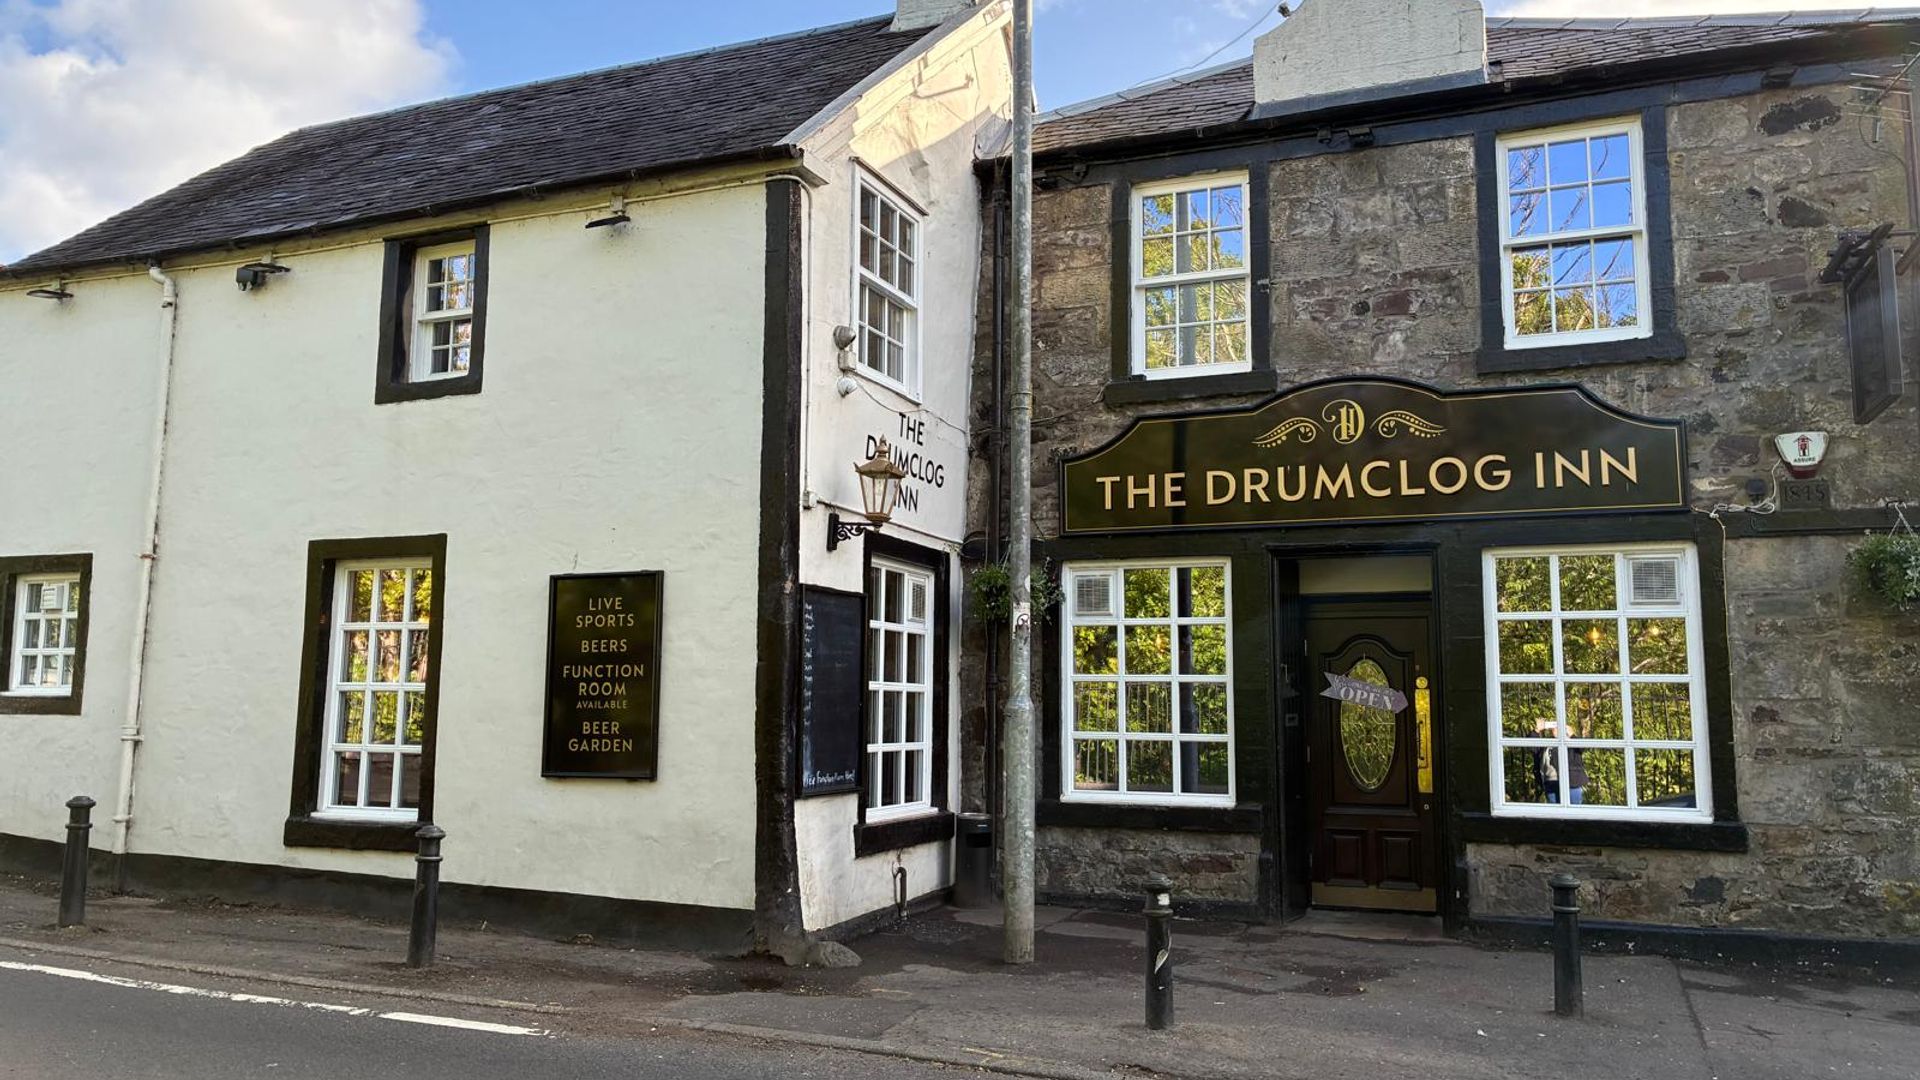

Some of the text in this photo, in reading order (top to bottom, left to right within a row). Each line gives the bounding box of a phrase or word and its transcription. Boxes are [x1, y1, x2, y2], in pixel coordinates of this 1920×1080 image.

[898, 412, 925, 446] THE
[865, 434, 945, 488] DUMCLOG
[1096, 447, 1639, 510] THE DRUMCLOG INN
[588, 597, 623, 611] LIVE
[576, 613, 635, 628] SPORTS
[581, 639, 628, 653] BEERS
[563, 664, 644, 679] FUNCTION
[578, 682, 627, 696] ROOM
[576, 700, 628, 709] AVAILABLE
[1340, 686, 1396, 710] OPEN
[582, 721, 620, 735] BEER
[568, 738, 633, 752] GARDEN
